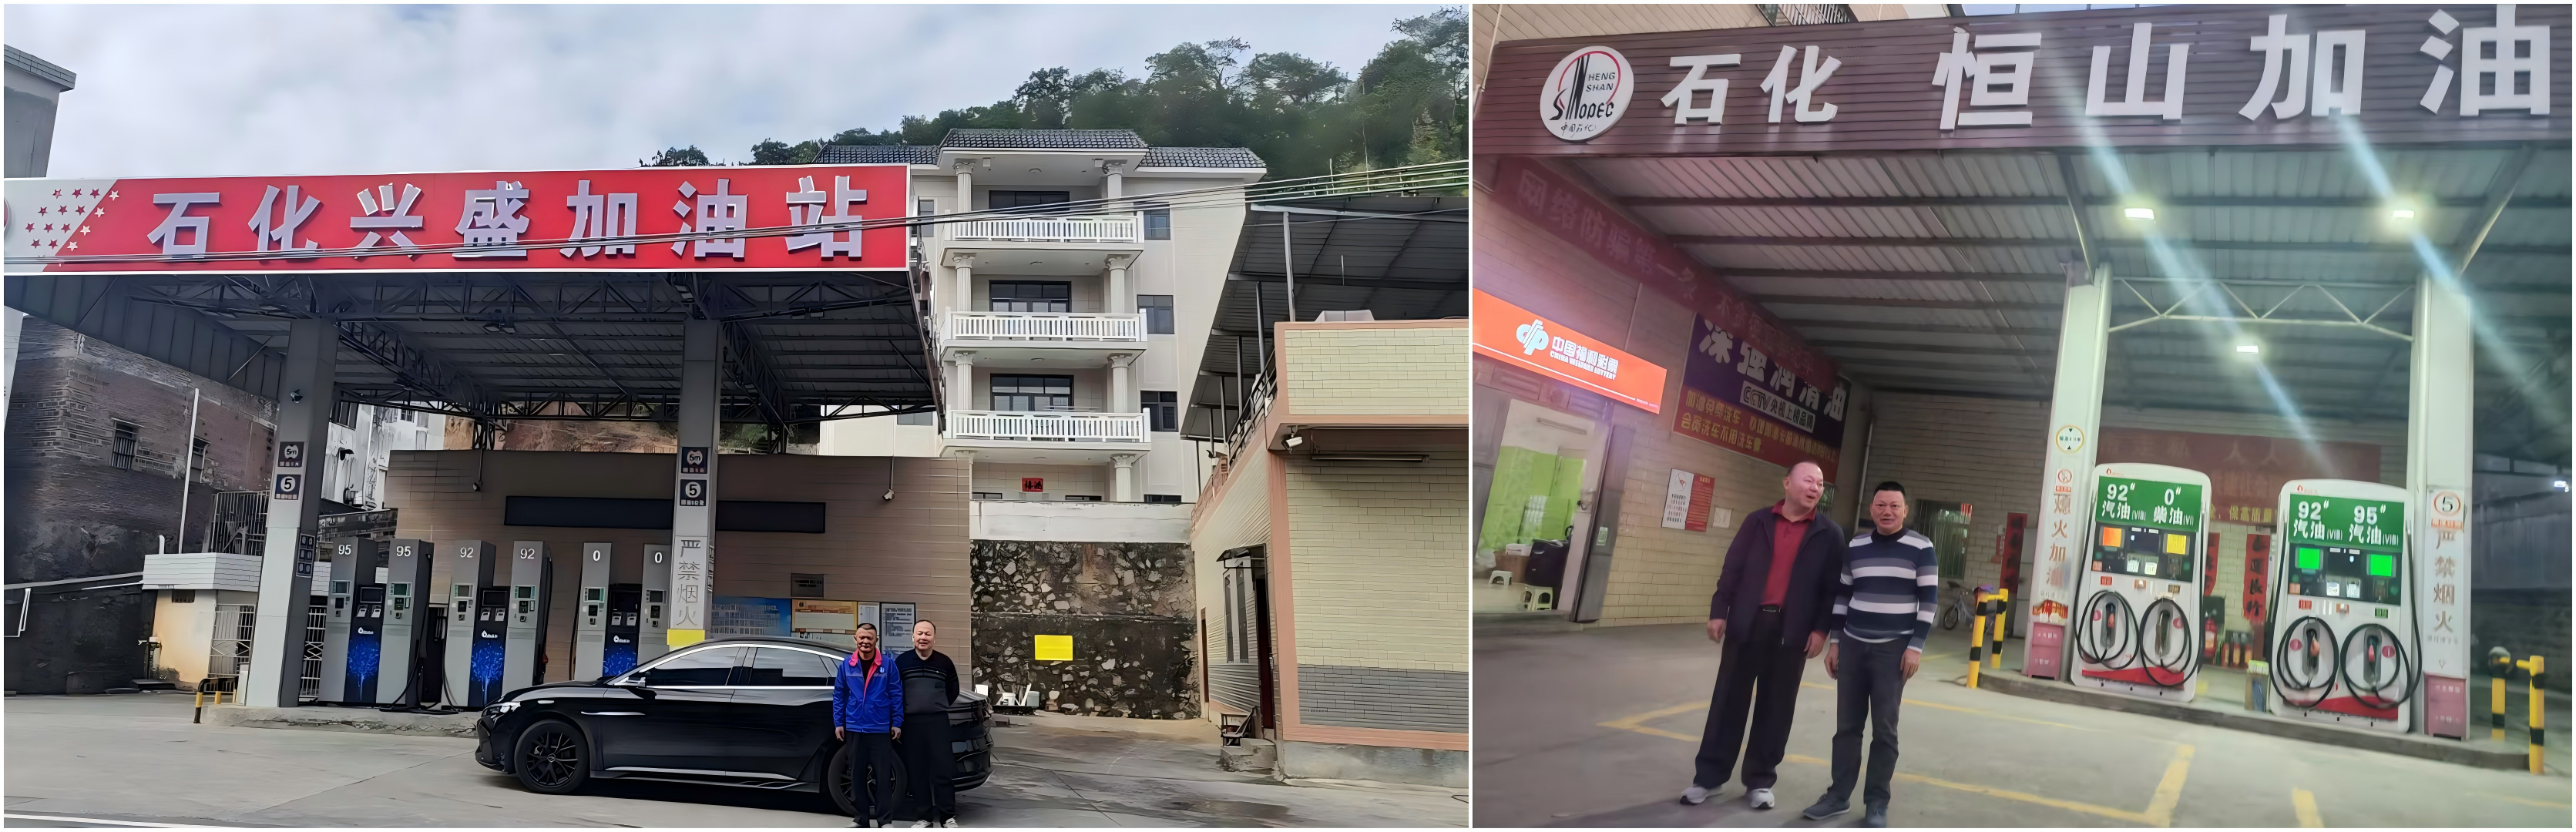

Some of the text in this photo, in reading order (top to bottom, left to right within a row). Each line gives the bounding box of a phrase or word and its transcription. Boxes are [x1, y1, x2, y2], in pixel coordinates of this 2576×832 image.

[1661, 4, 2551, 131] 石化 恒山加油
[1587, 72, 1616, 82] HENG
[1585, 82, 1614, 92] SHAN
[146, 175, 868, 260] 石化兴盛加油站
[1551, 335, 1619, 374] 中国福利彩票
[284, 478, 293, 490] 5
[689, 484, 697, 496] 5
[2442, 495, 2453, 513] 5
[338, 545, 351, 555] 95
[396, 545, 411, 557] 95
[460, 547, 474, 559] 92
[520, 548, 536, 559] 92
[593, 549, 601, 562] 0
[654, 552, 663, 563] 0
[677, 539, 700, 627] 严禁烟火
[2433, 530, 2456, 633] 严禁烟火
